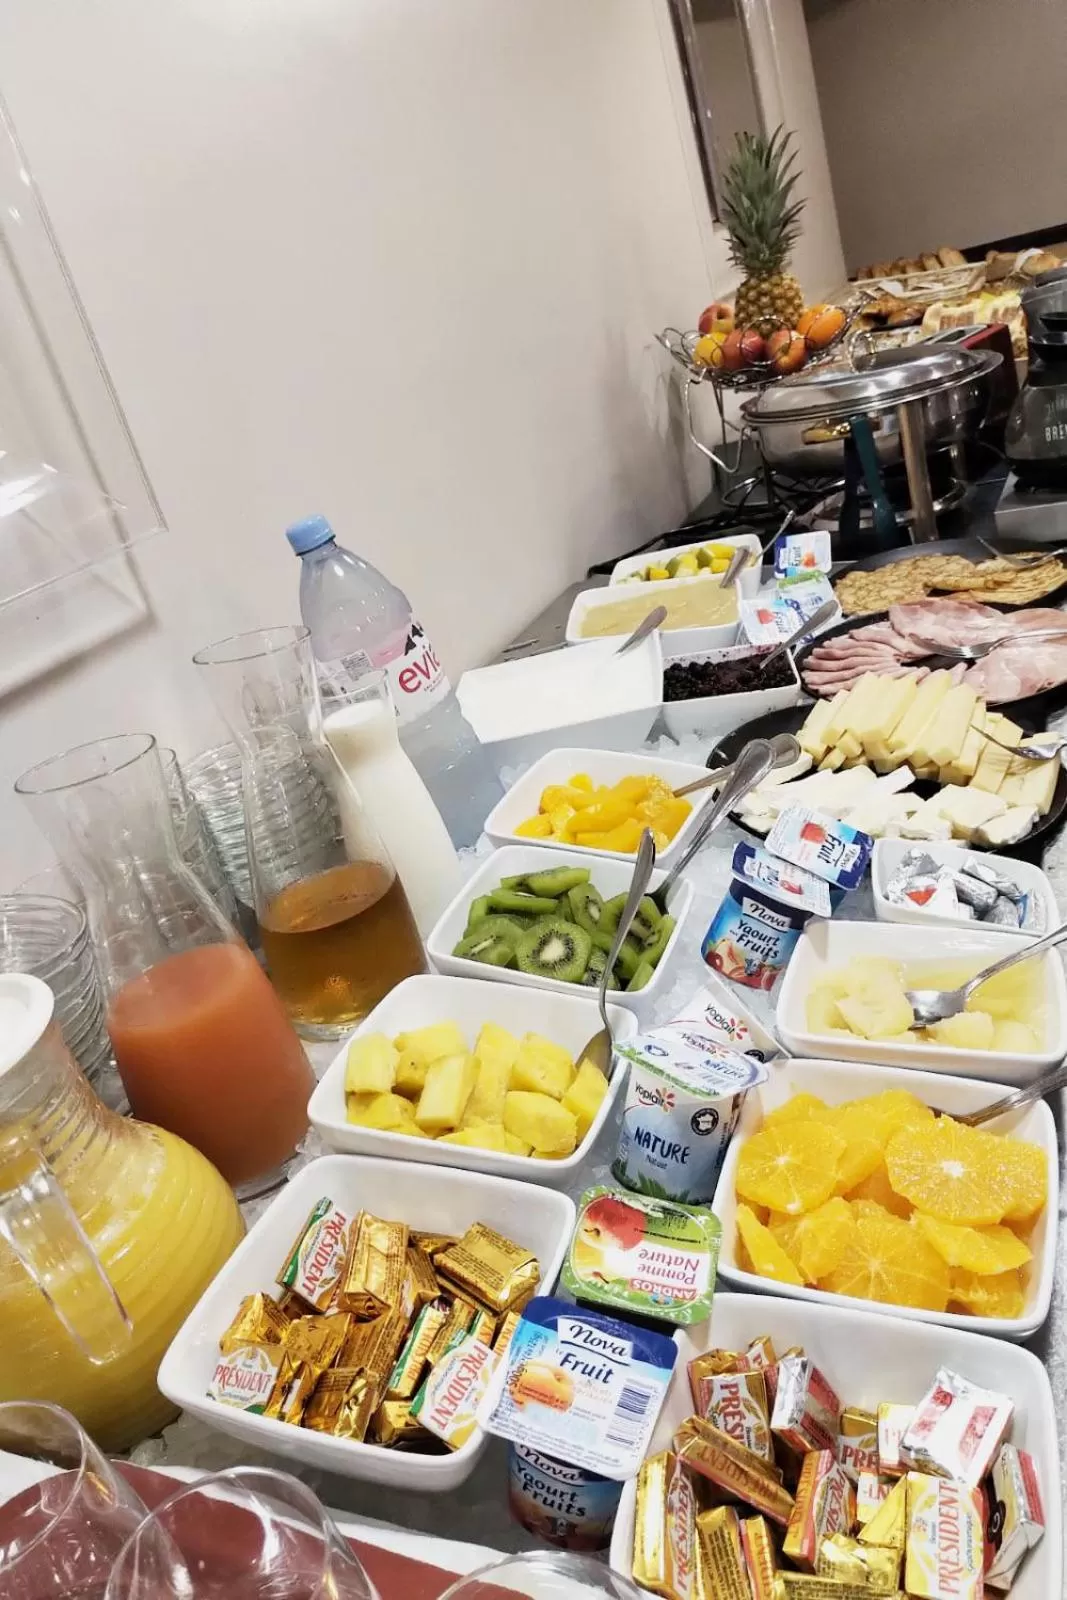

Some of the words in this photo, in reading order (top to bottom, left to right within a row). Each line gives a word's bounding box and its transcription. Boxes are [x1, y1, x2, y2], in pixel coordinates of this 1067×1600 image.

[817, 833, 842, 865] Fruit
[749, 902, 788, 928] Nova
[736, 919, 782, 947] Yaourt
[736, 933, 781, 960] Fruits
[633, 1125, 691, 1165] NATURE
[637, 1263, 697, 1286] Pomme
[638, 1248, 700, 1273] Nature
[633, 1280, 695, 1300] ANDROS
[569, 1323, 629, 1358] Nova
[212, 1362, 273, 1394] PRÉSIDENT
[559, 1352, 615, 1385] Fruit
[719, 1382, 747, 1444] PRÉSI
[519, 1443, 581, 1482] Nova
[515, 1461, 580, 1502] Yaourt
[521, 1482, 588, 1518] Fruits
[938, 1480, 963, 1595] PRÉSIDENT
